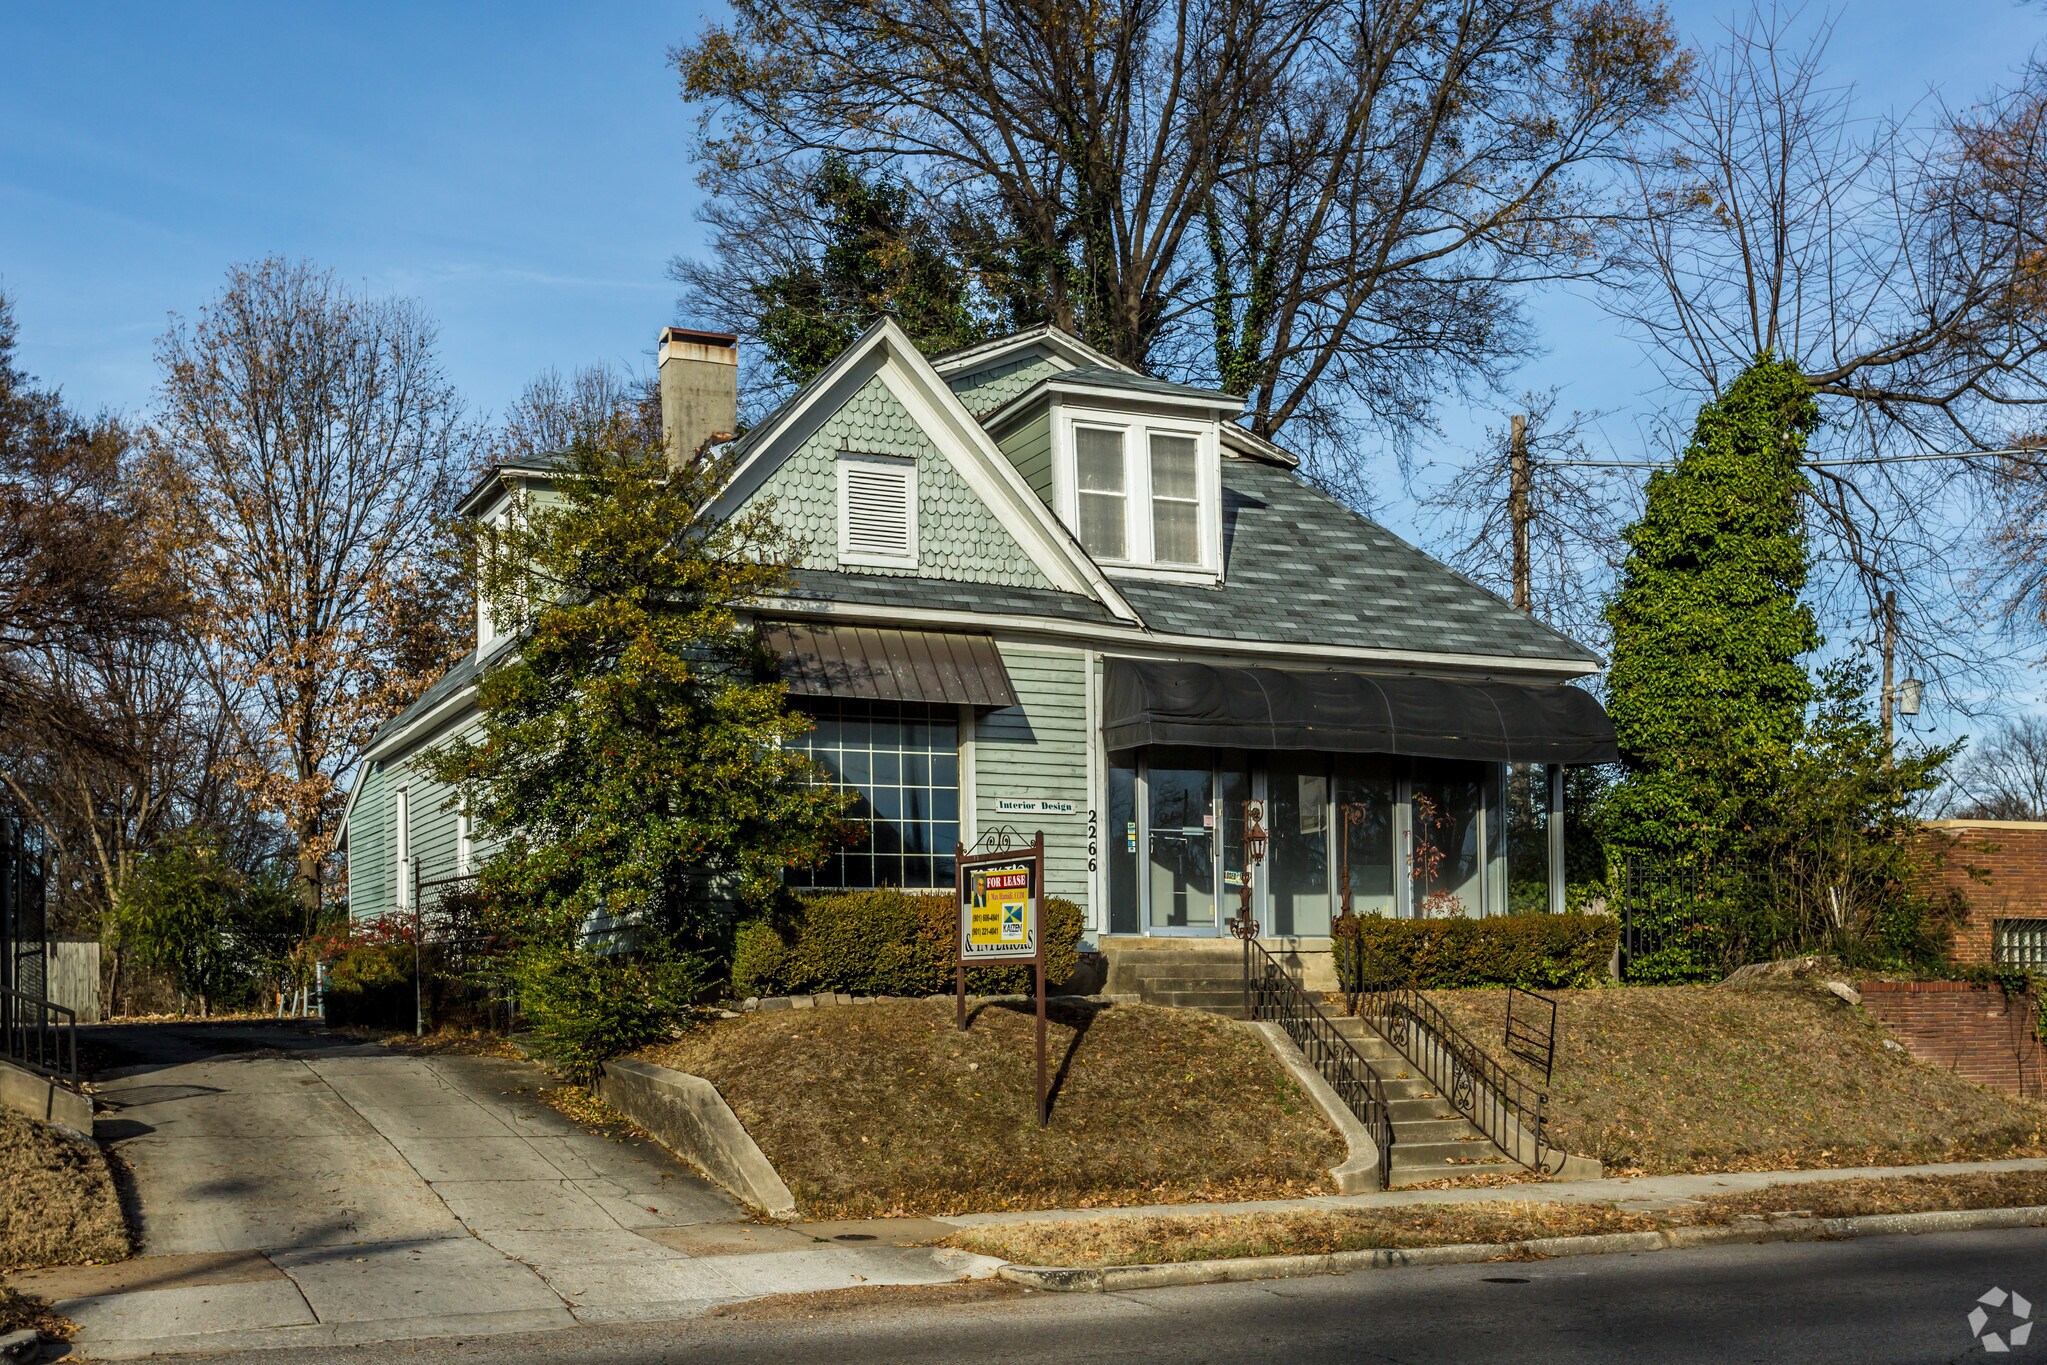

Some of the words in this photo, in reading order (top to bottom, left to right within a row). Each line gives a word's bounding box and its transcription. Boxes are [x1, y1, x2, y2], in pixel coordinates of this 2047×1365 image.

[999, 800, 1036, 810] Interior
[1041, 801, 1072, 812] Design
[1088, 810, 1097, 872] 2266
[987, 877, 1001, 888] FOR
[1003, 874, 1026, 887] LEASE
[1003, 923, 1022, 933] KAIZEN
